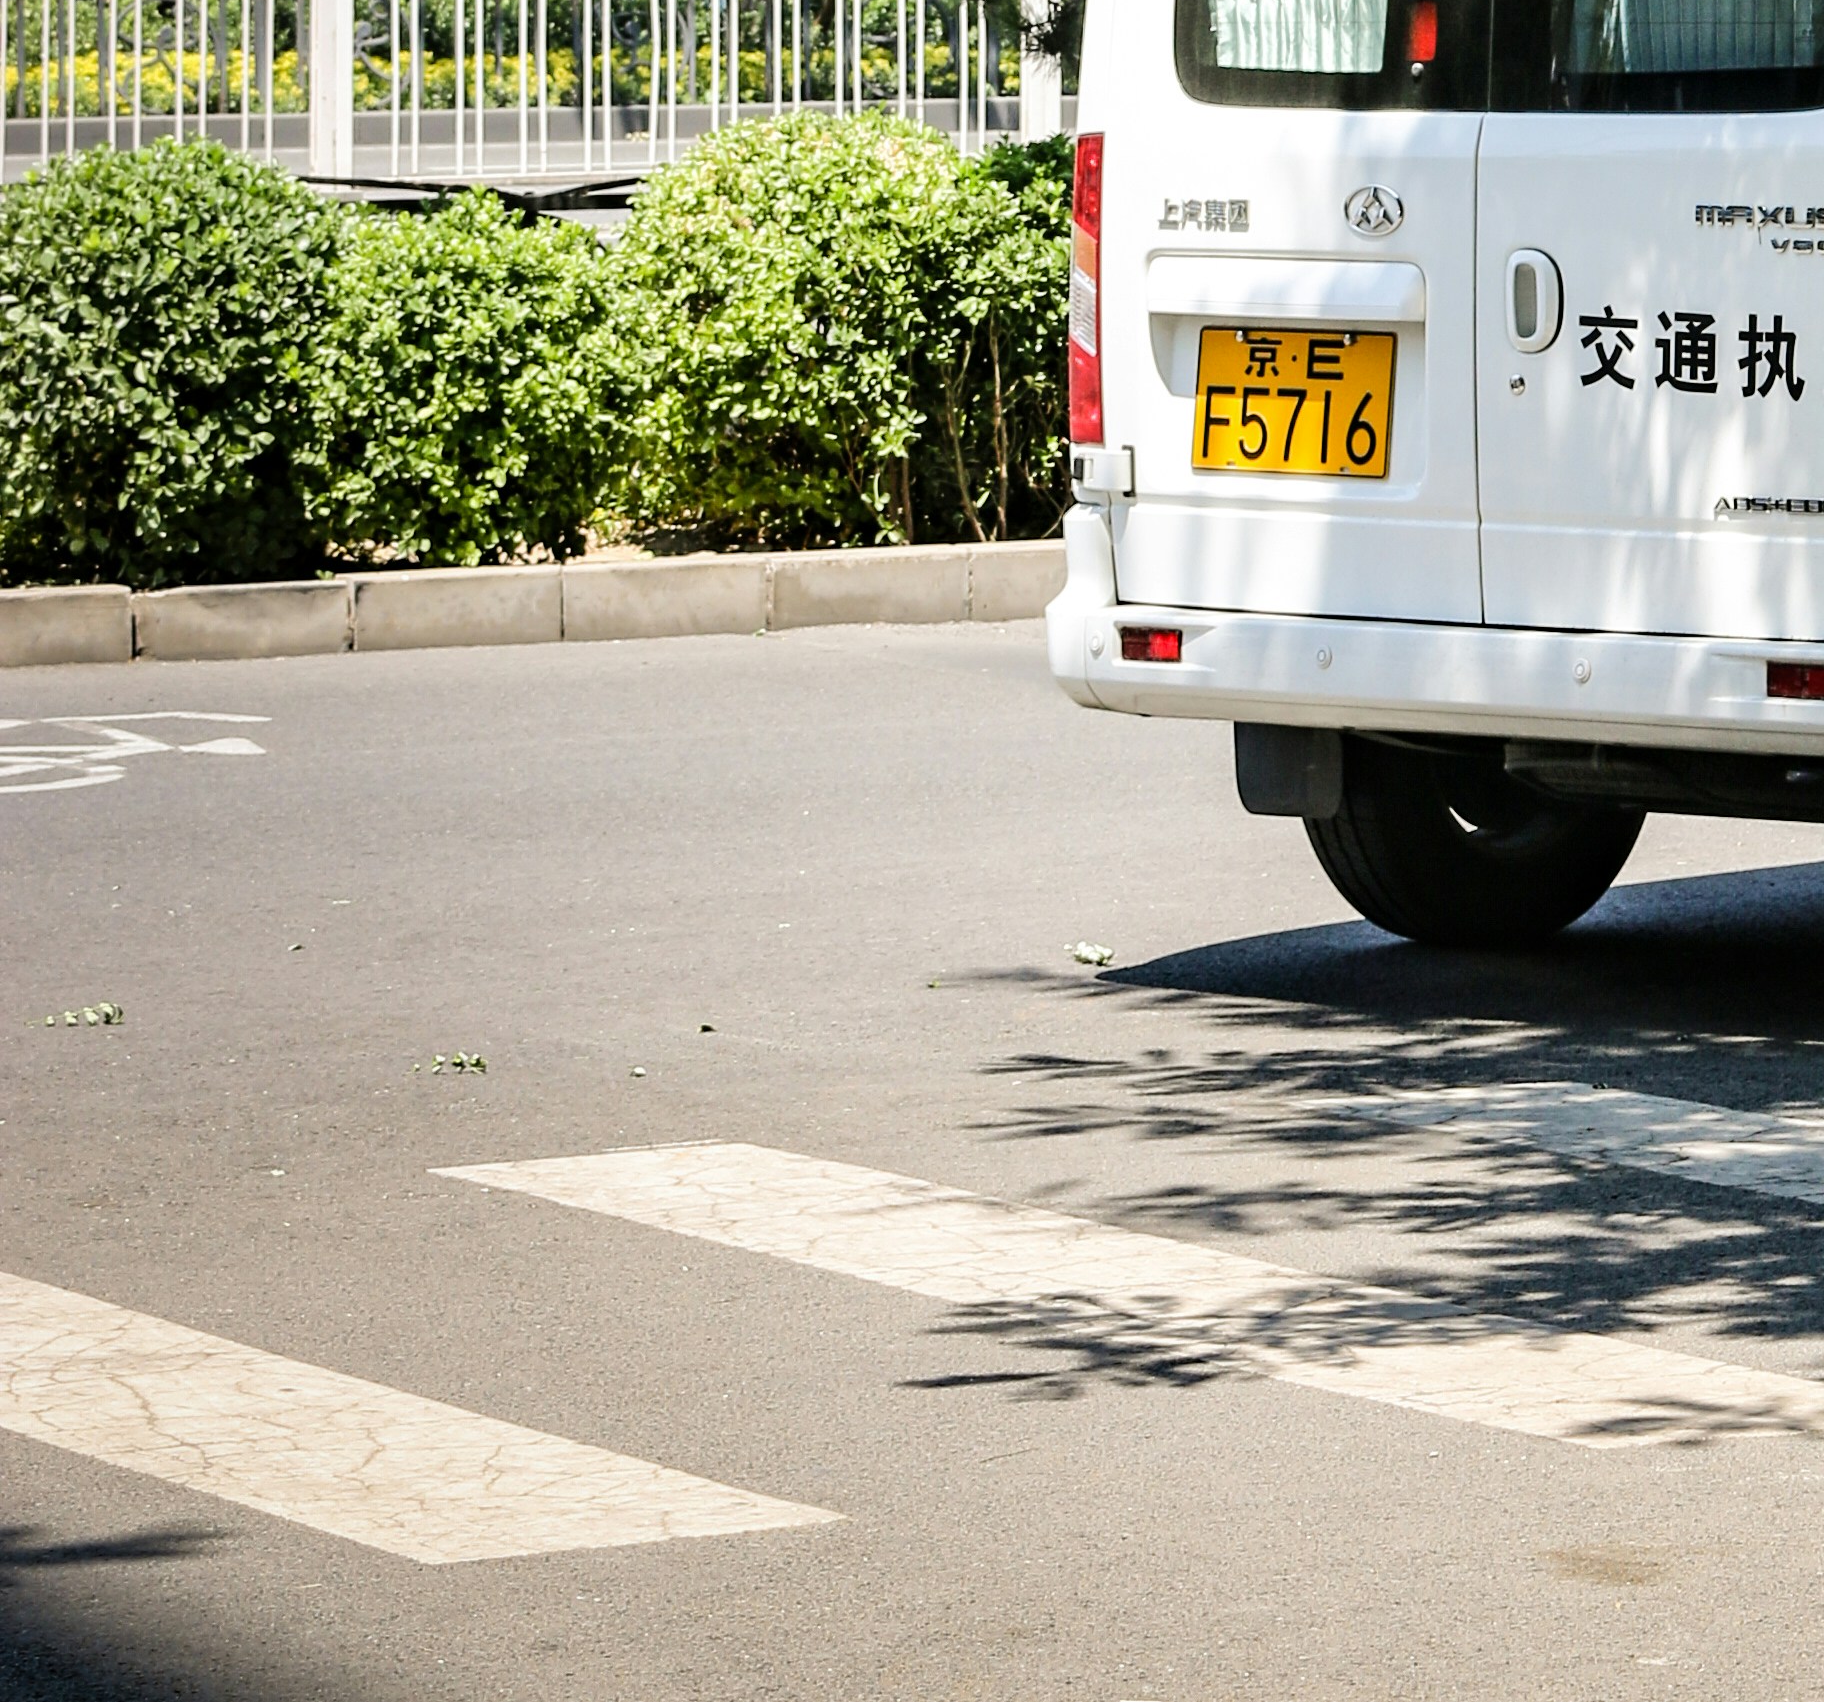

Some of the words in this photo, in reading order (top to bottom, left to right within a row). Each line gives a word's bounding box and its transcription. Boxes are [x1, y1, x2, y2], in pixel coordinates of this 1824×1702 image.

[1158, 198, 1251, 231] 上汽集团
[1202, 384, 1378, 466] F5716
